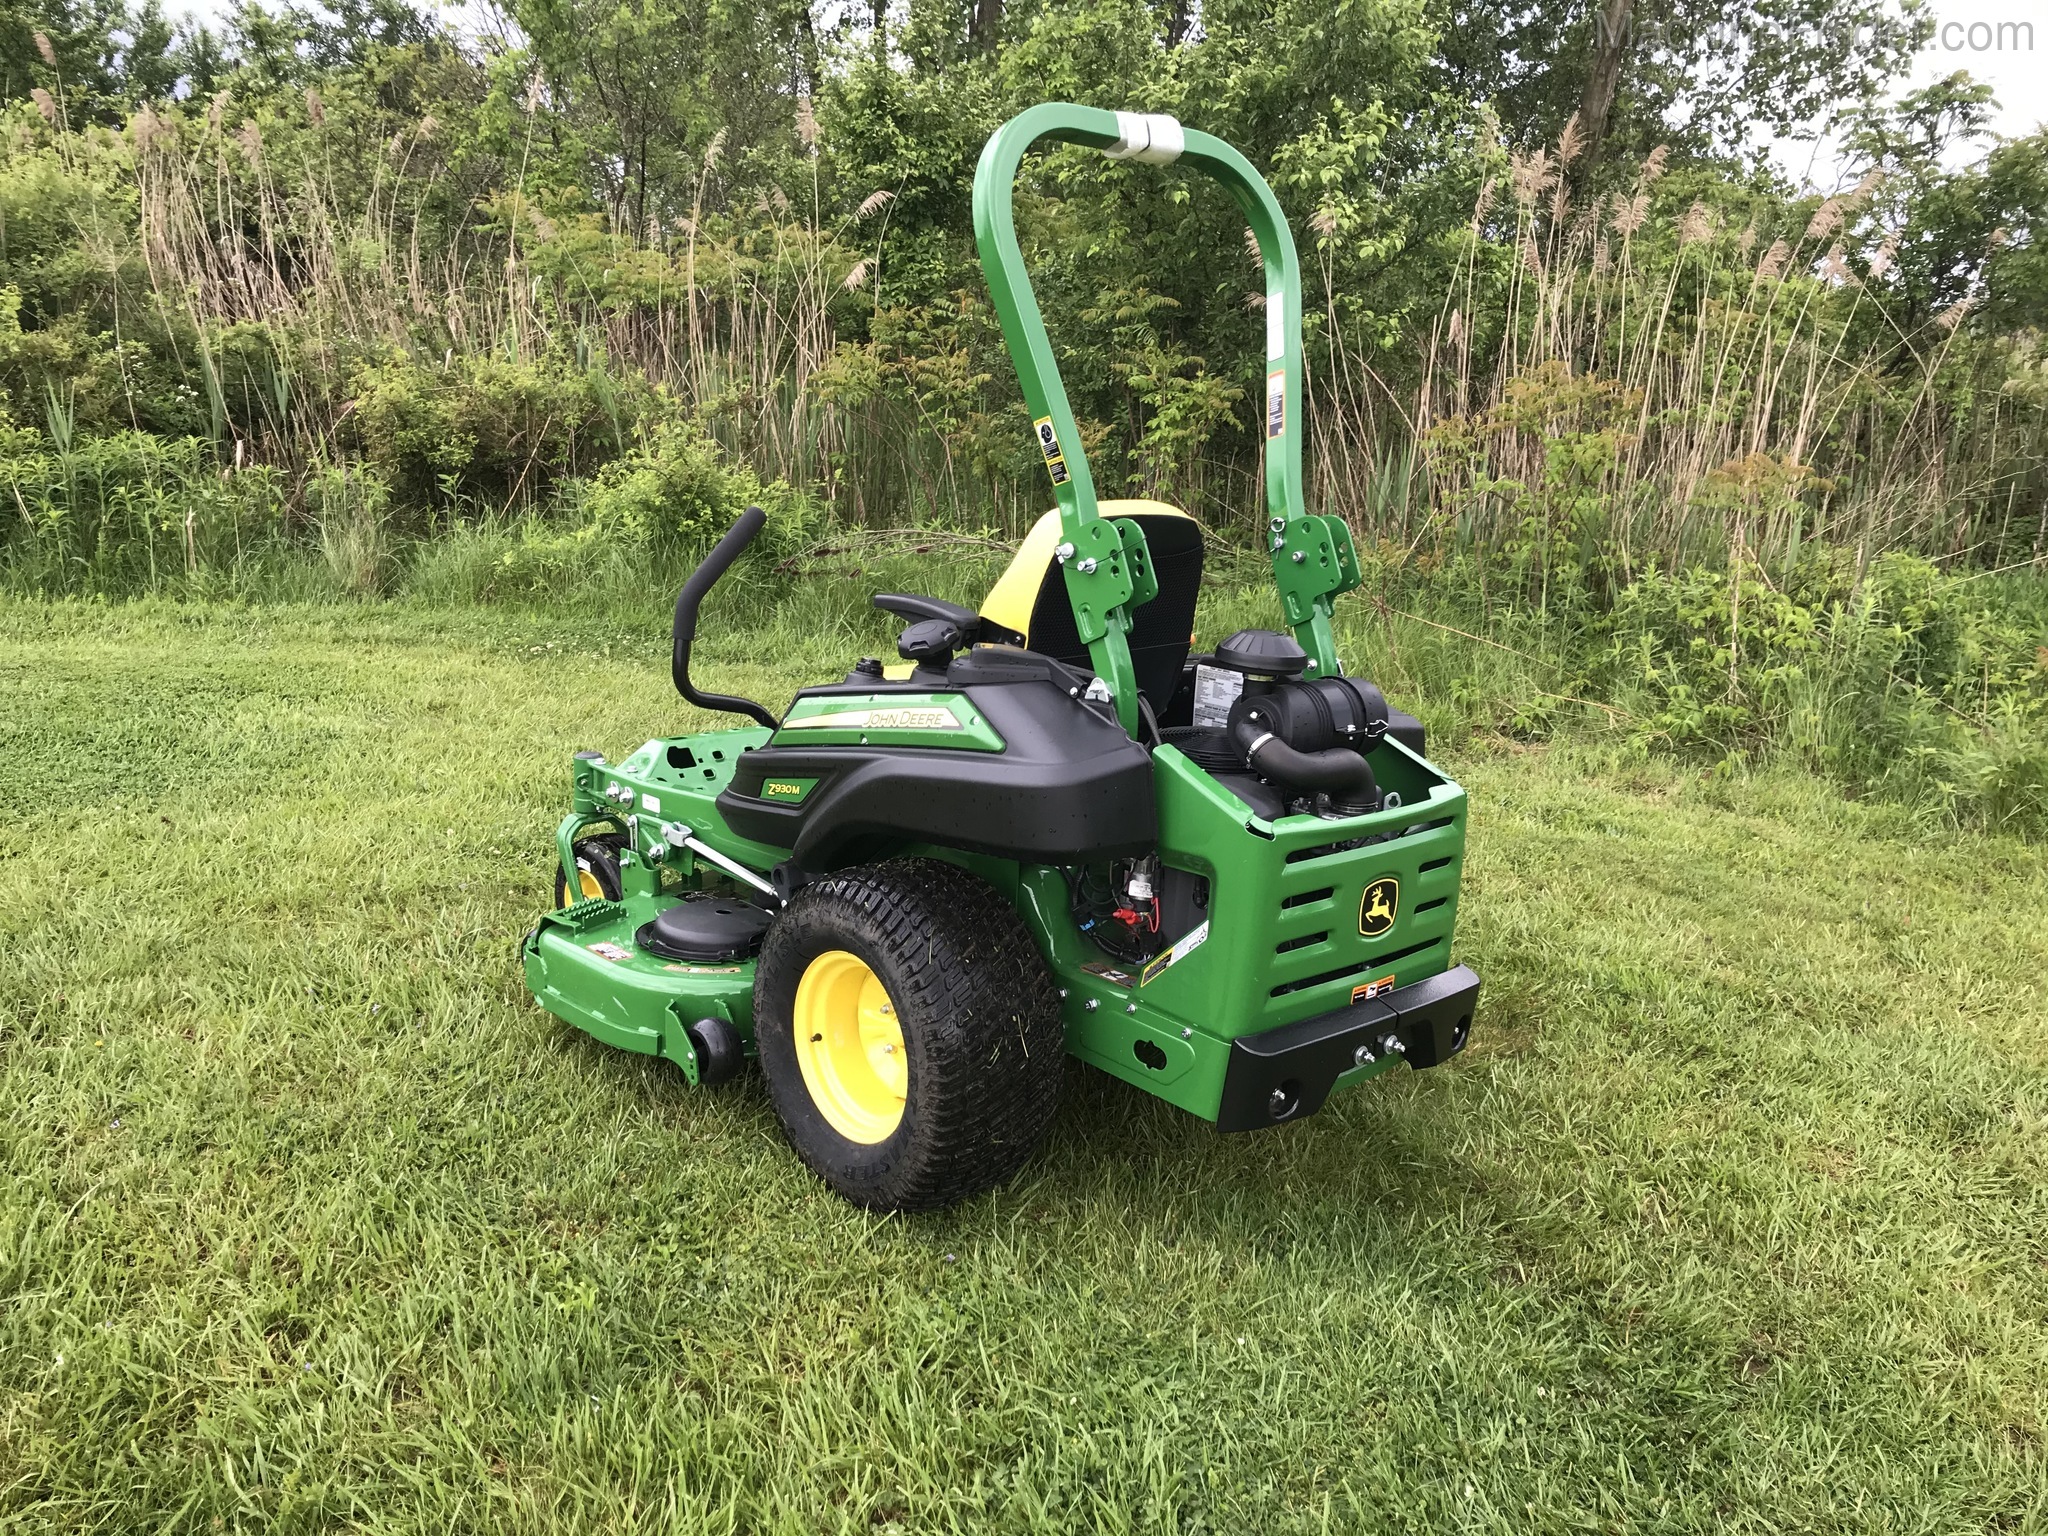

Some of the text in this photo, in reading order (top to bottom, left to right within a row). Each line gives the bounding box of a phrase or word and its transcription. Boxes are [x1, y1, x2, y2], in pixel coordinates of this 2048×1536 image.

[863, 711, 944, 726] JOHN DEERE
[768, 783, 800, 796] Z930M
